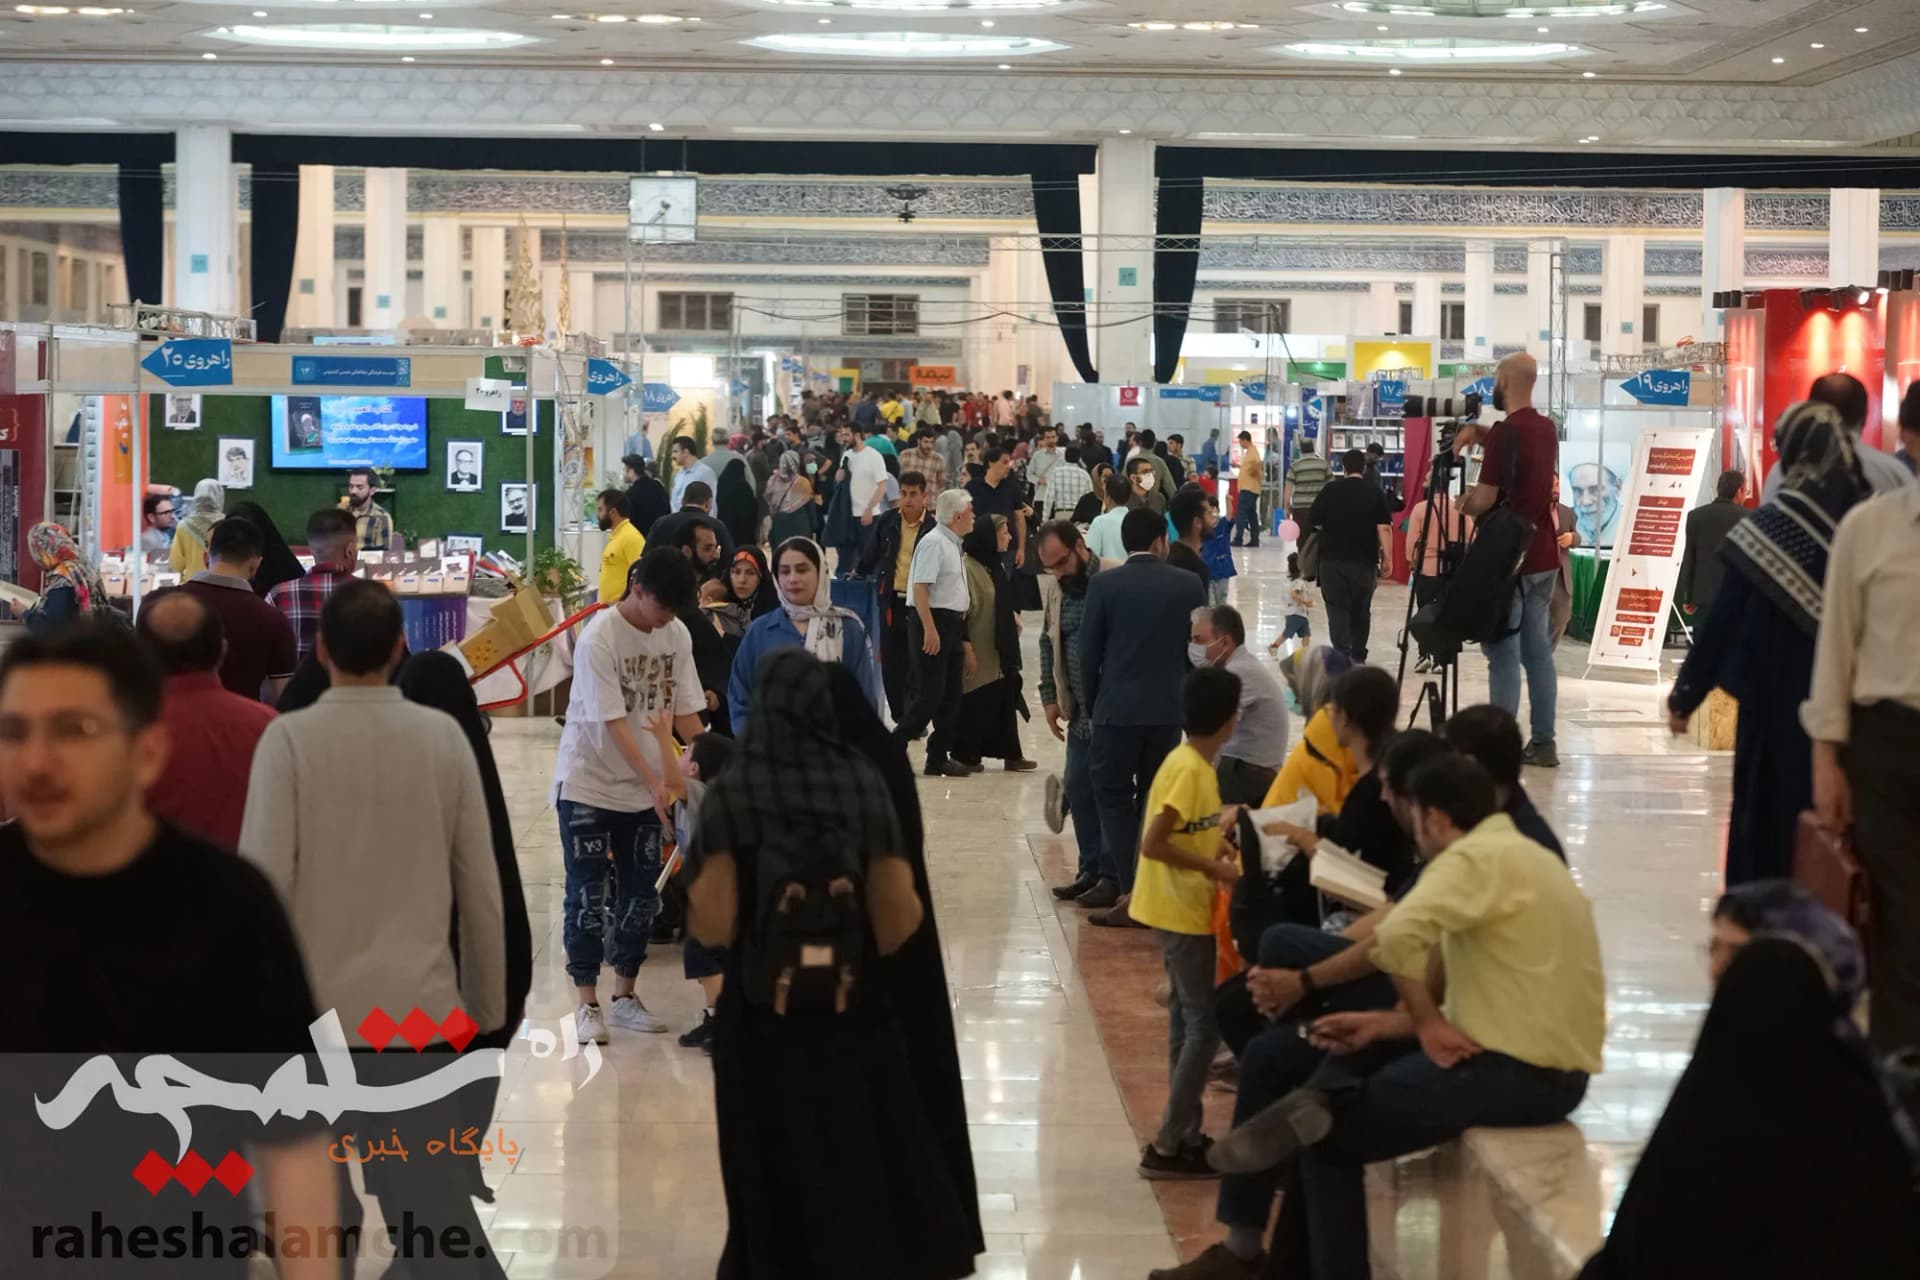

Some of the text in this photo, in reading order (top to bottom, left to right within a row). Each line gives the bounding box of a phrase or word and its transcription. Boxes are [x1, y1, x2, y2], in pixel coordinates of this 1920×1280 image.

[184, 349, 231, 371] راهروی
[588, 370, 623, 386] راهروی
[1637, 374, 1688, 395] راهروی ۱۹
